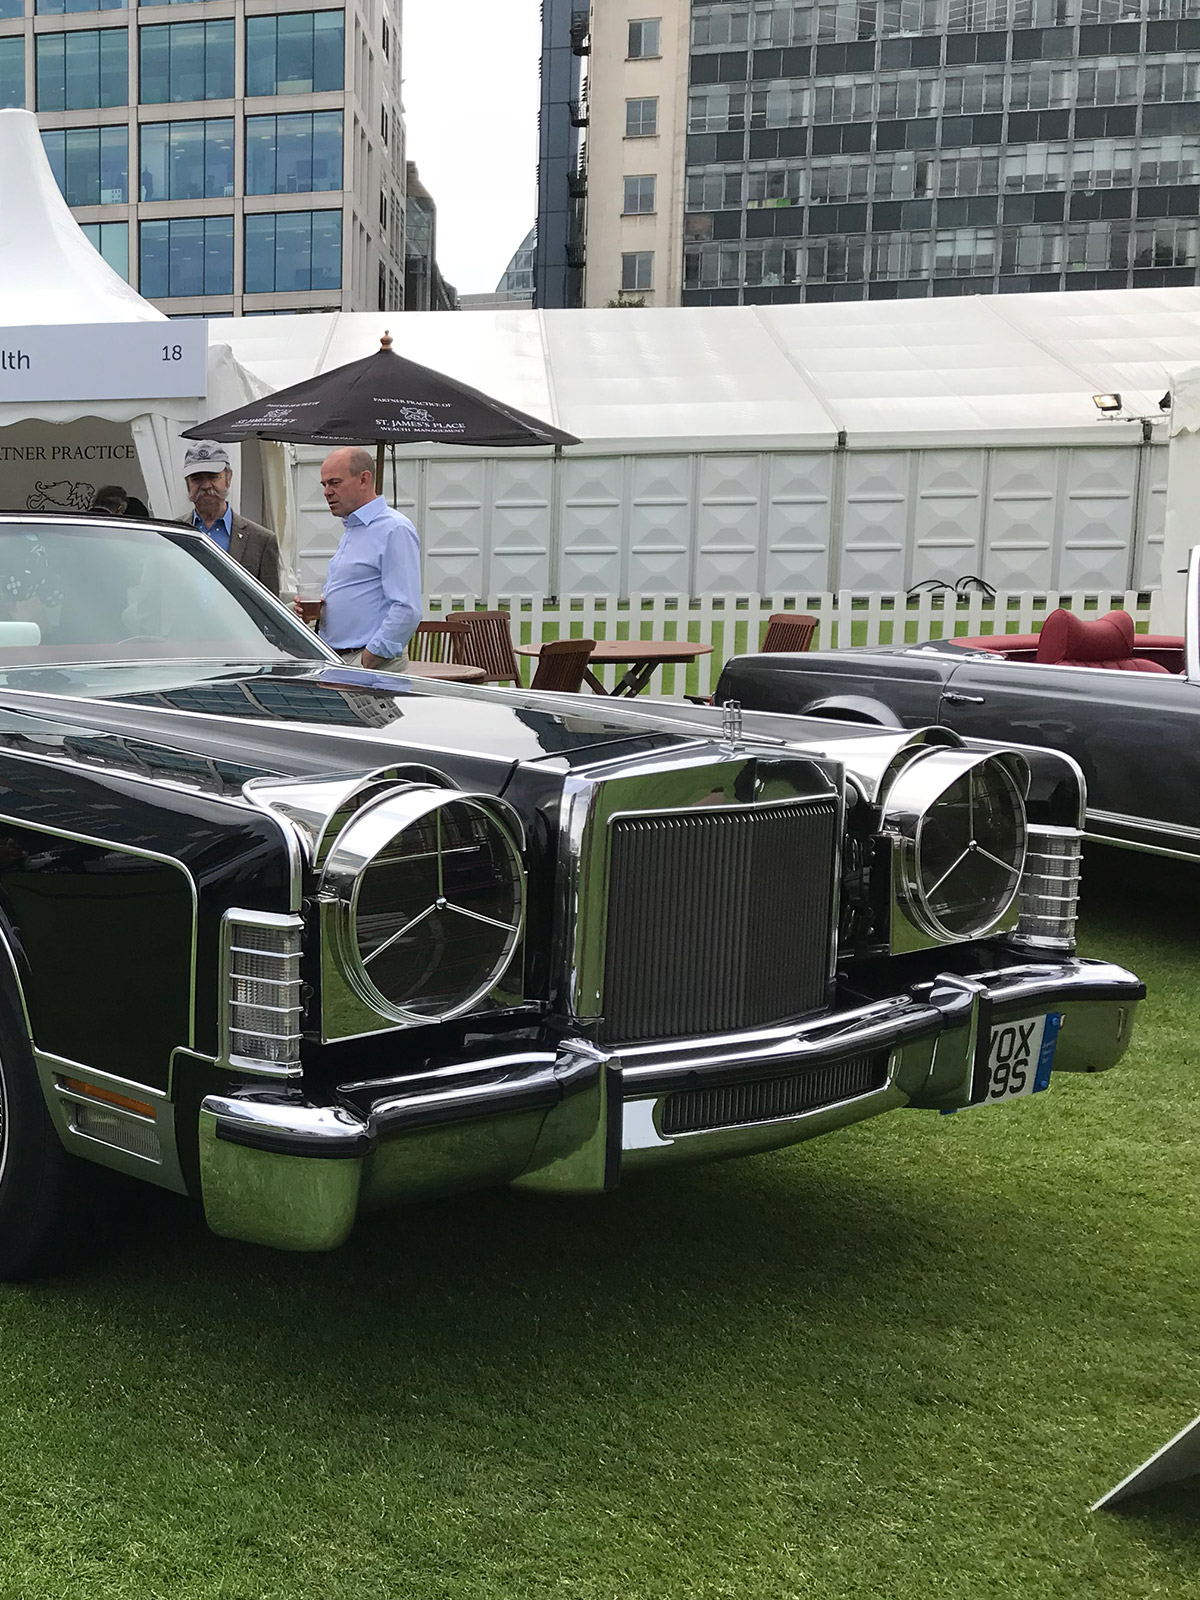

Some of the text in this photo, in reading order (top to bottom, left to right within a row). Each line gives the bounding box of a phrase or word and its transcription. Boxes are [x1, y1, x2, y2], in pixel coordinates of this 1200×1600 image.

[161, 345, 183, 361] 18
[391, 419, 430, 428] JAMES'S
[51, 445, 136, 460] PRACTICE
[987, 1058, 1029, 1099] 9S
